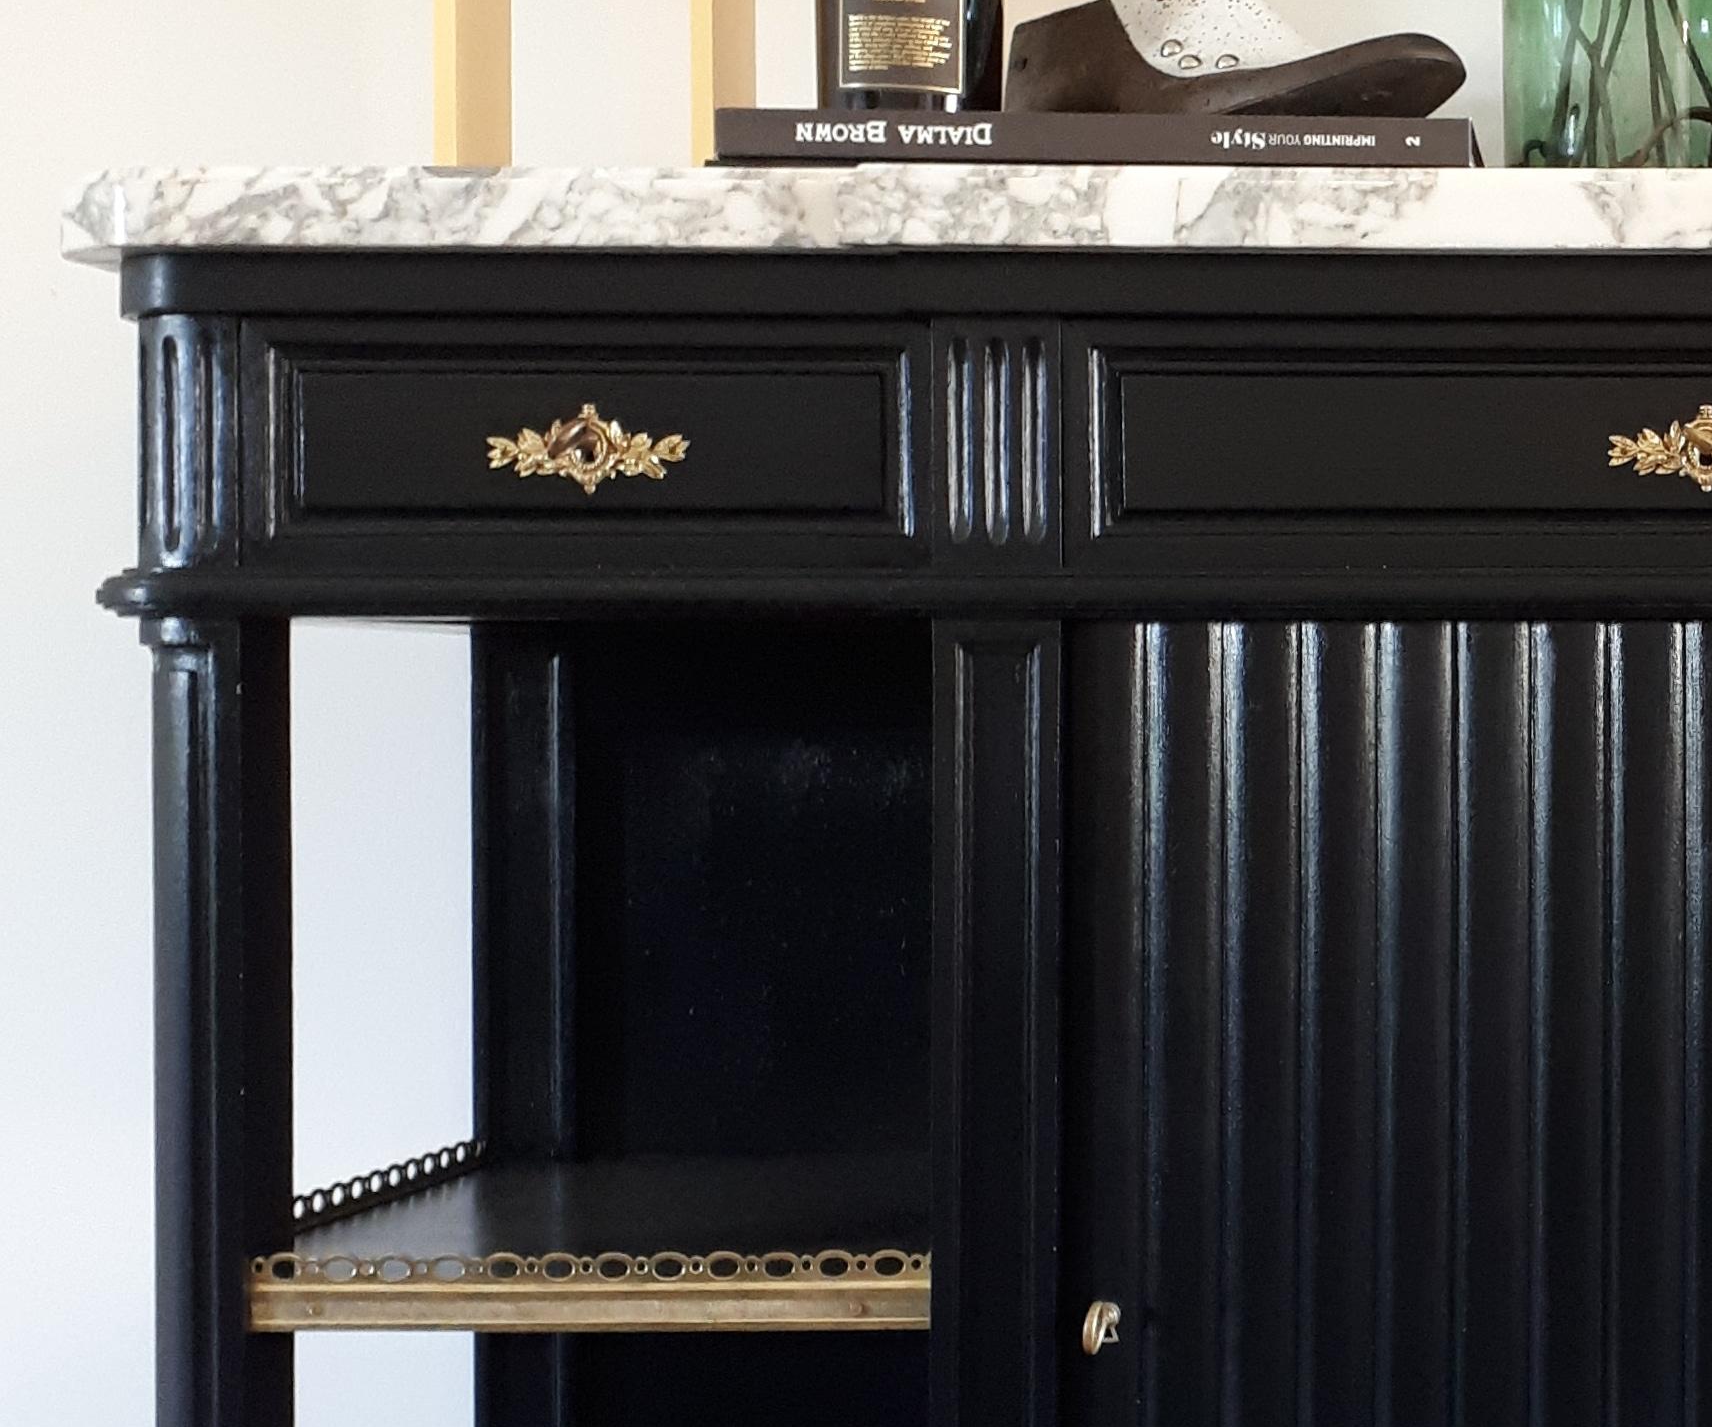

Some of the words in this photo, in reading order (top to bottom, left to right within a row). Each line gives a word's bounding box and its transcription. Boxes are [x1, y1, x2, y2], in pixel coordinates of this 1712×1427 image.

[794, 120, 888, 144] BROWN
[897, 123, 993, 146] DIALMA
[1209, 128, 1266, 150] Style
[1268, 133, 1302, 146] YOUR
[1303, 134, 1376, 147] IMPRINTING
